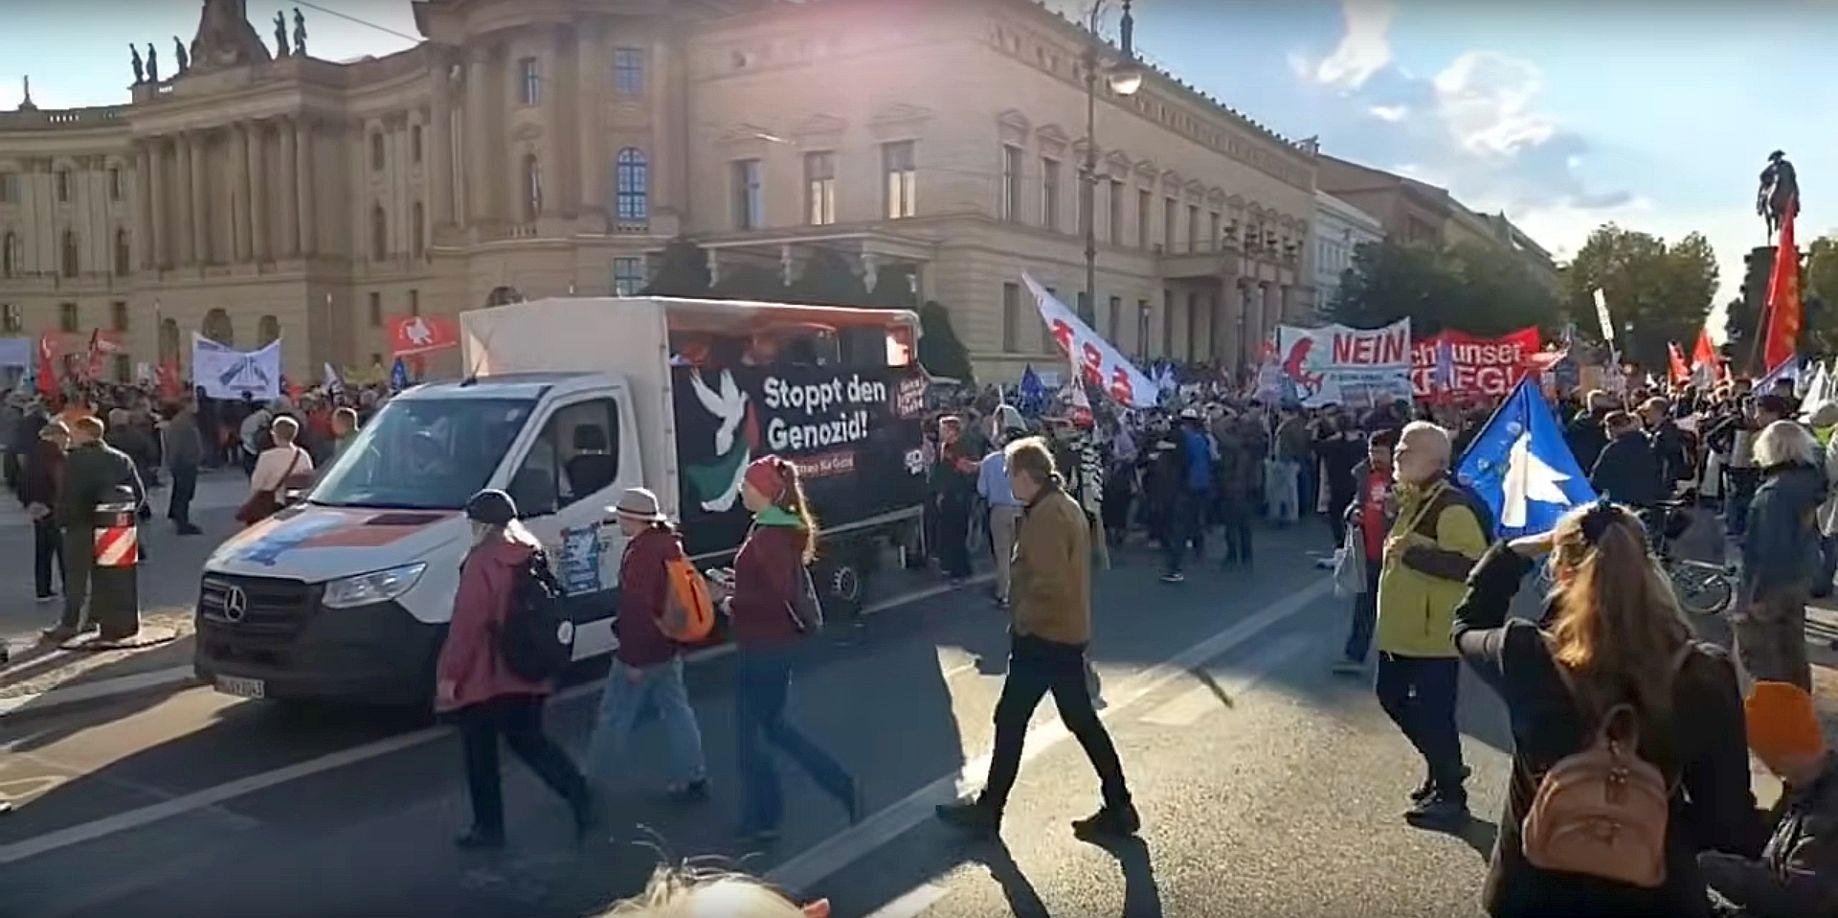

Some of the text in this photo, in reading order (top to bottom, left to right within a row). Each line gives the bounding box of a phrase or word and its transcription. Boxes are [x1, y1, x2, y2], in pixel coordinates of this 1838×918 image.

[1332, 328, 1406, 365] NEIN
[764, 376, 842, 415] Stoppt
[846, 373, 887, 402] den
[767, 410, 869, 451] Genozid!
